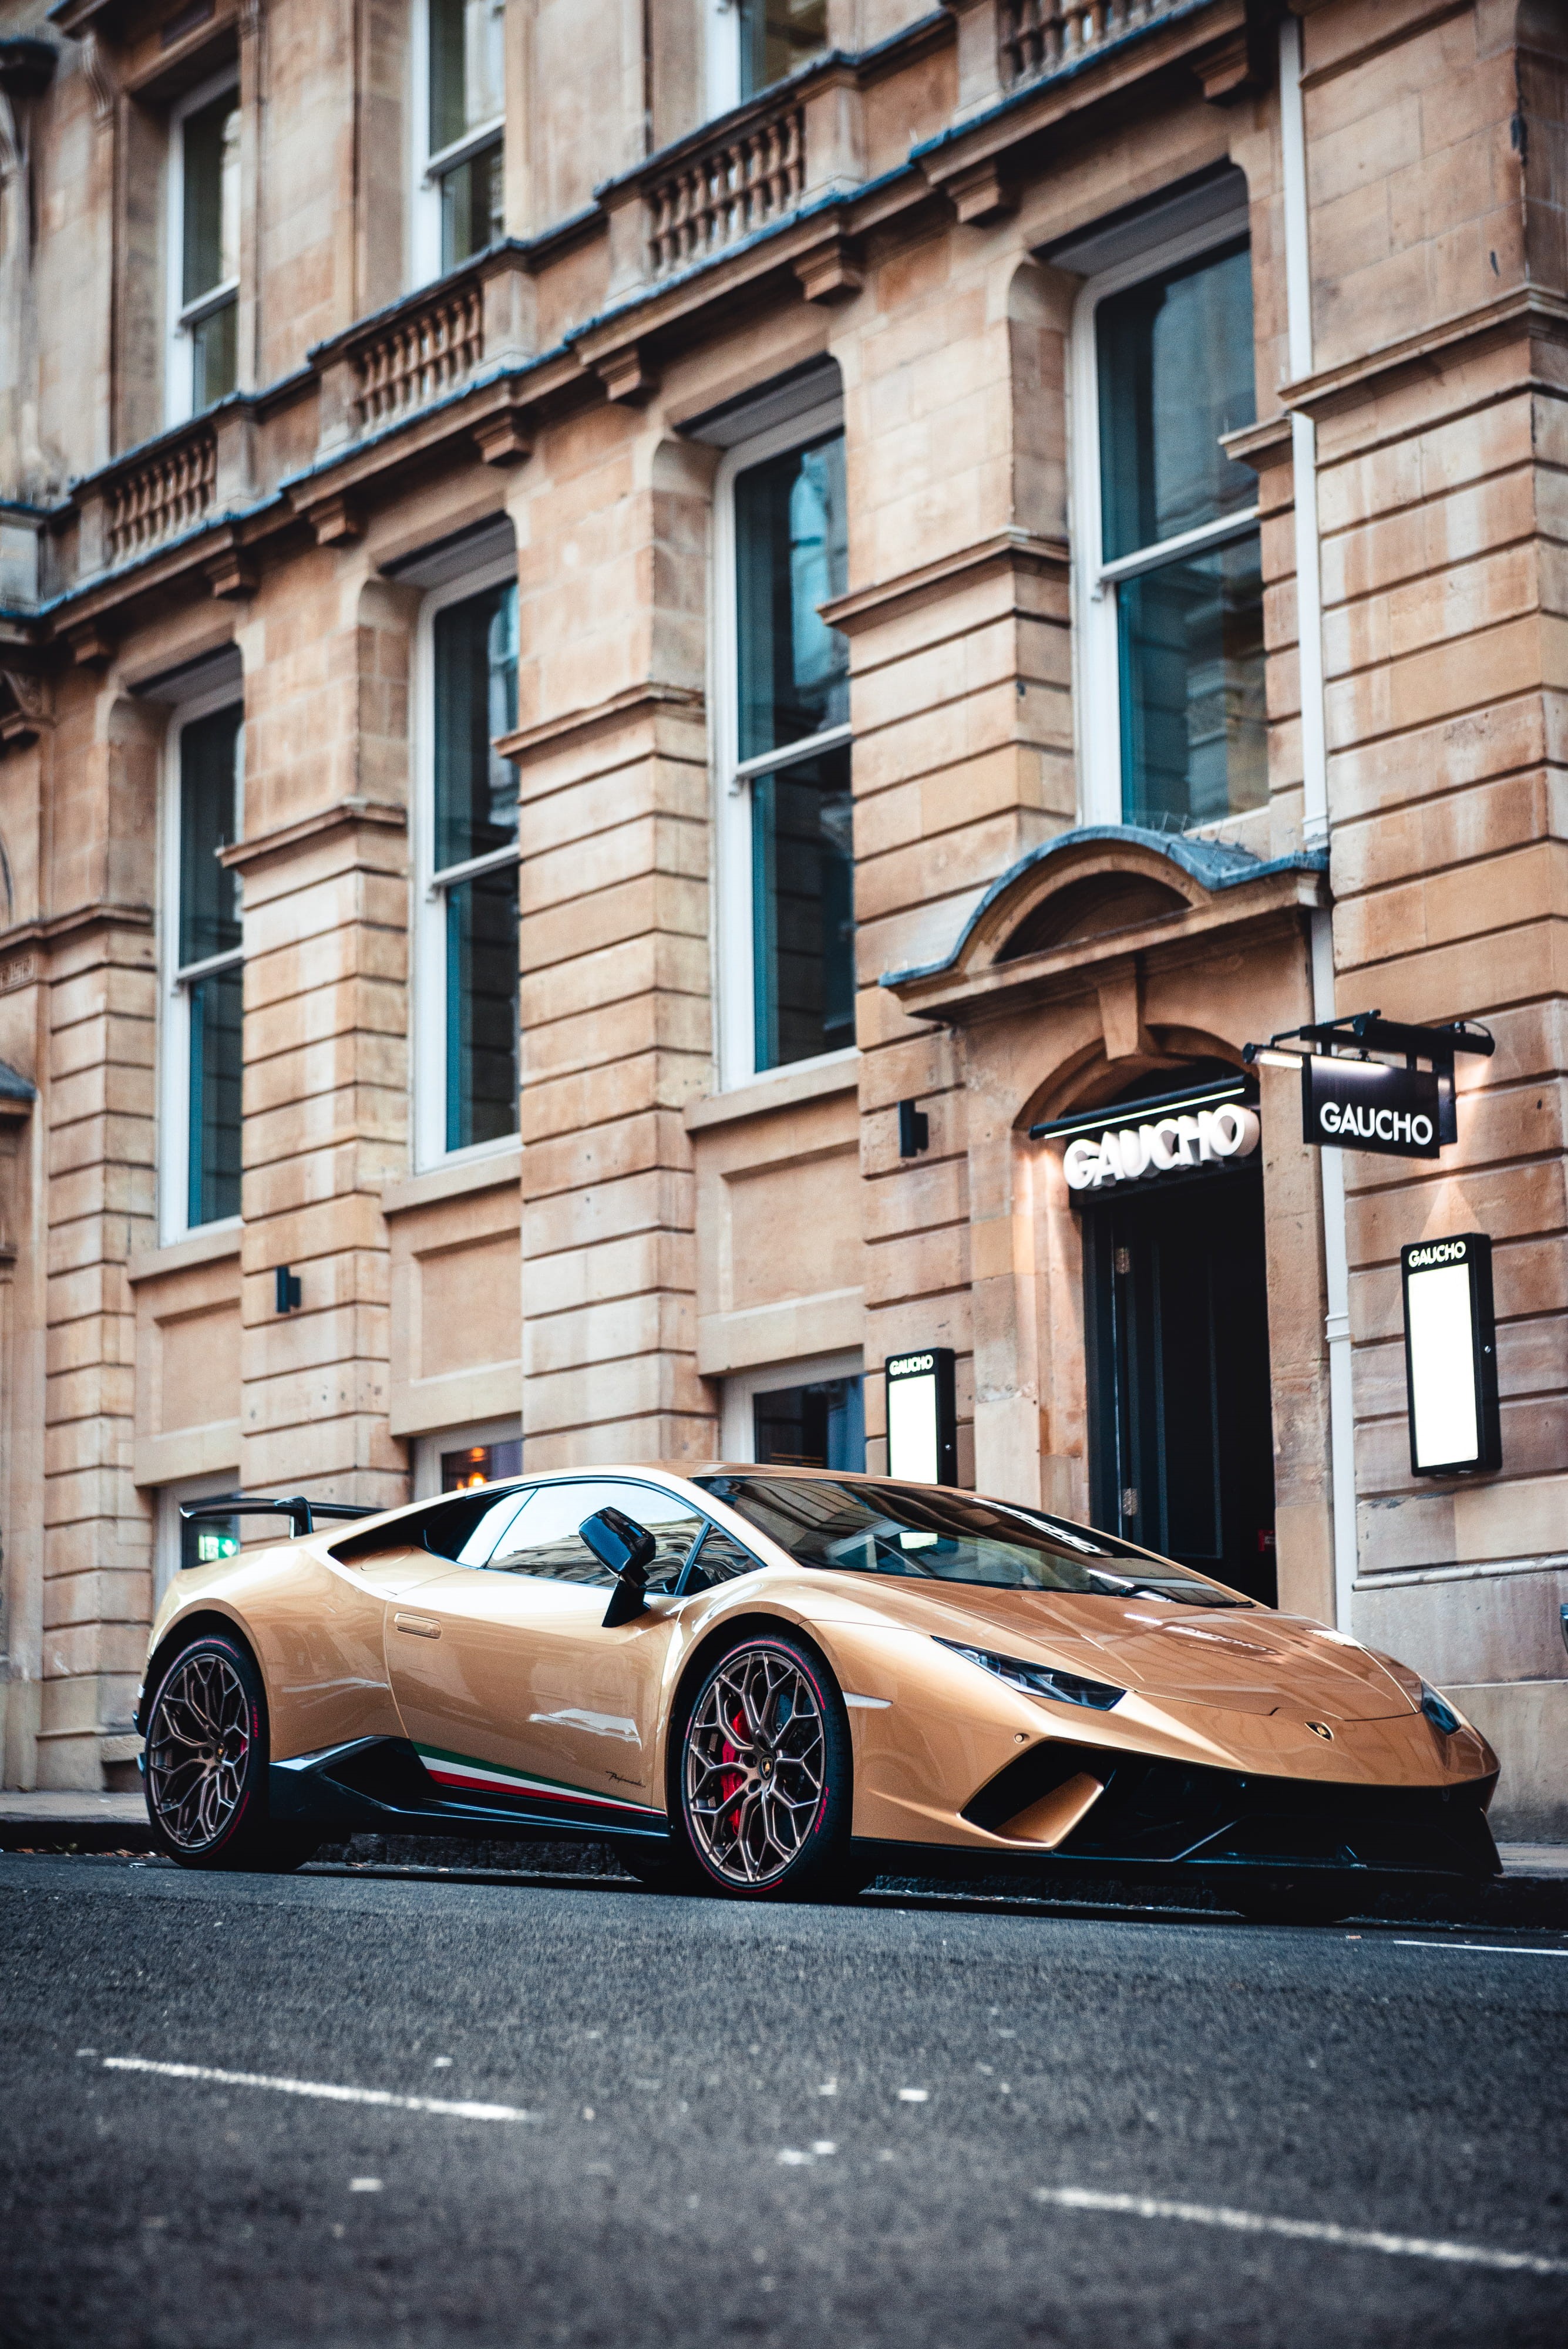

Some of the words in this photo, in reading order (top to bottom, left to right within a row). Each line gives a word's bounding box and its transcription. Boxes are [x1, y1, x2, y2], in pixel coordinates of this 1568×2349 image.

[1320, 1101, 1433, 1145] GAUCHO
[1063, 1103, 1260, 1190] GAUCHO
[1408, 1241, 1466, 1268] GAUCHO
[889, 1354, 934, 1376] GAUCHO
